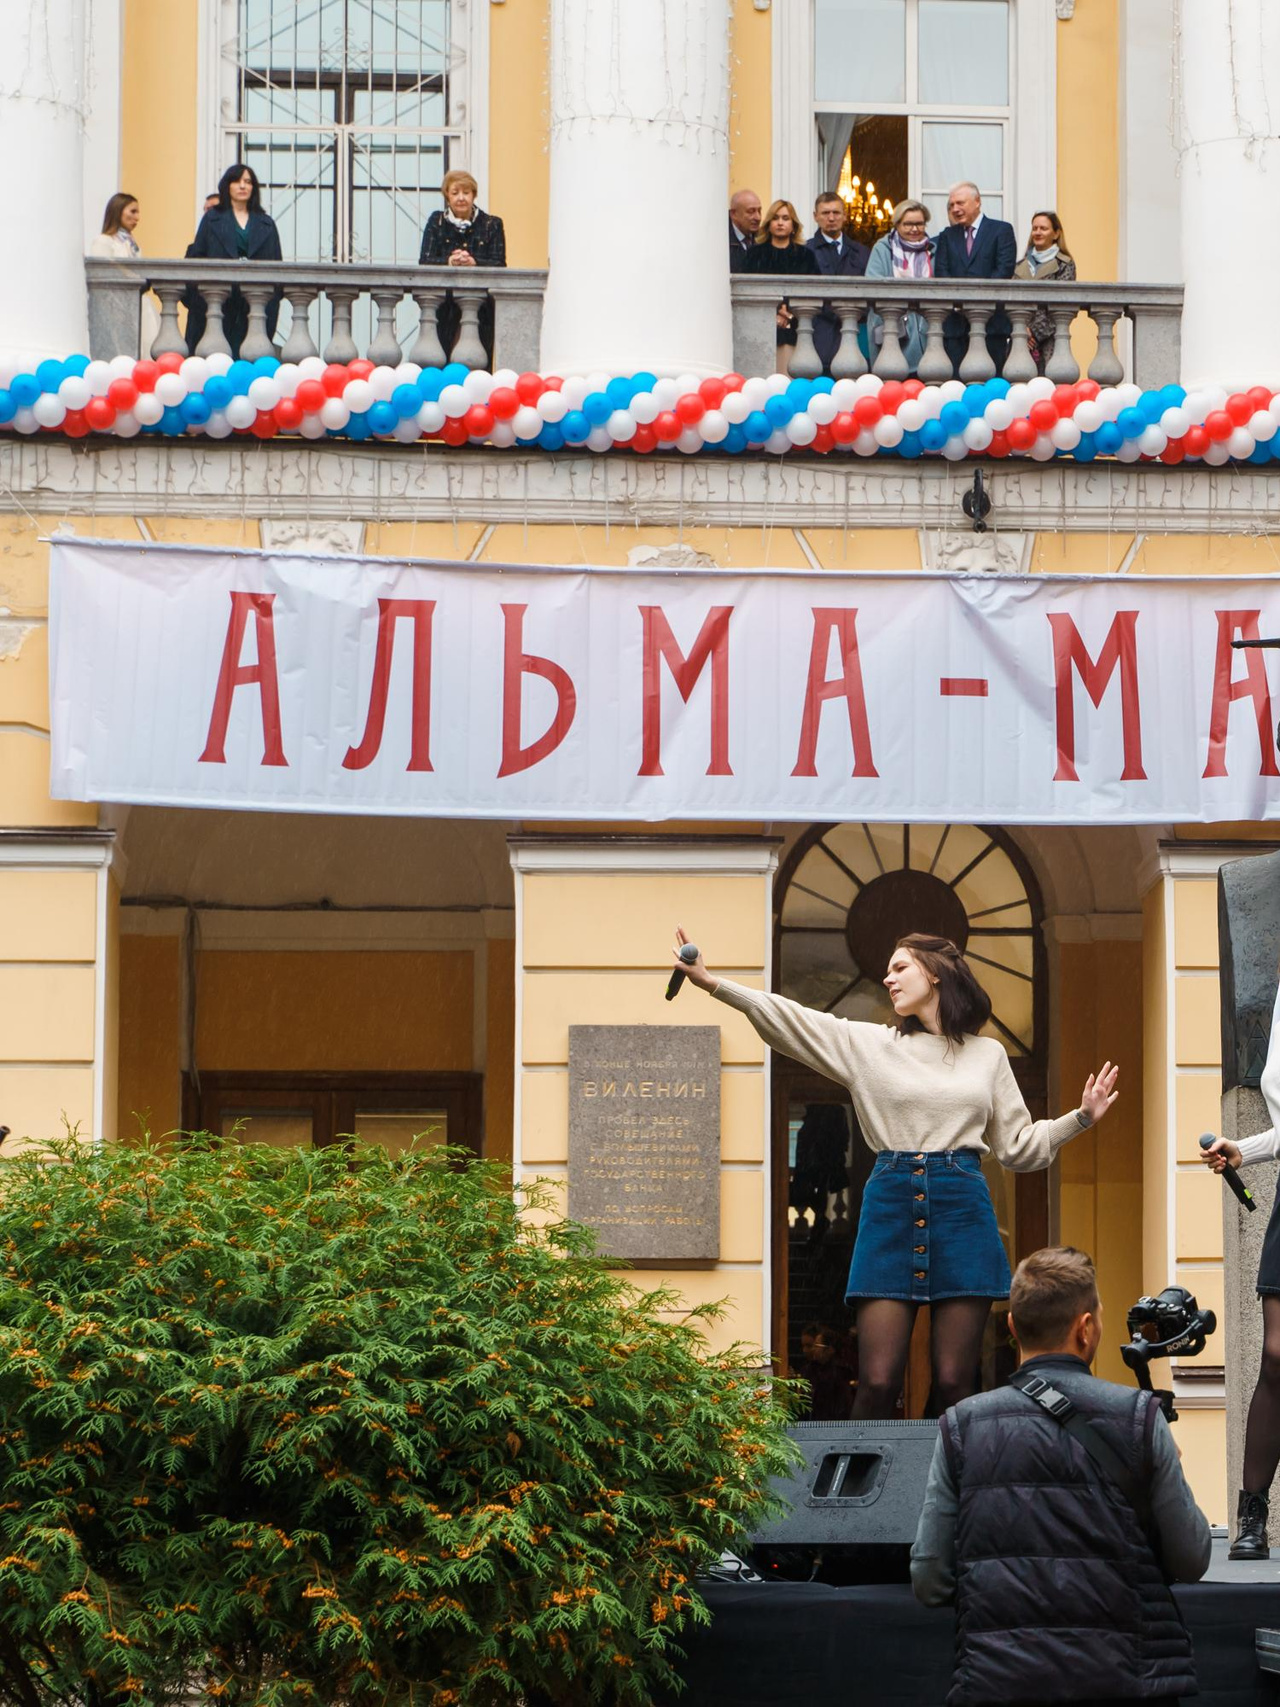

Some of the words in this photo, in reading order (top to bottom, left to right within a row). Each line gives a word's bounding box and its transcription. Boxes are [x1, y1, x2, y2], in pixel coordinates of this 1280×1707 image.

[636, 1060, 679, 1069] НОЯБРЯ
[598, 1115, 646, 1125] ПРОВЕЛ
[651, 1115, 690, 1126] ЗДЕСЬ
[605, 1129, 684, 1140] СОВЕЩАНИЕ
[589, 1155, 700, 1166] РУКОВОДИТЕЛЯМИ
[583, 1169, 707, 1180] ГОСУДАРСТВЕННОГО
[1166, 1334, 1190, 1353] RONIN
